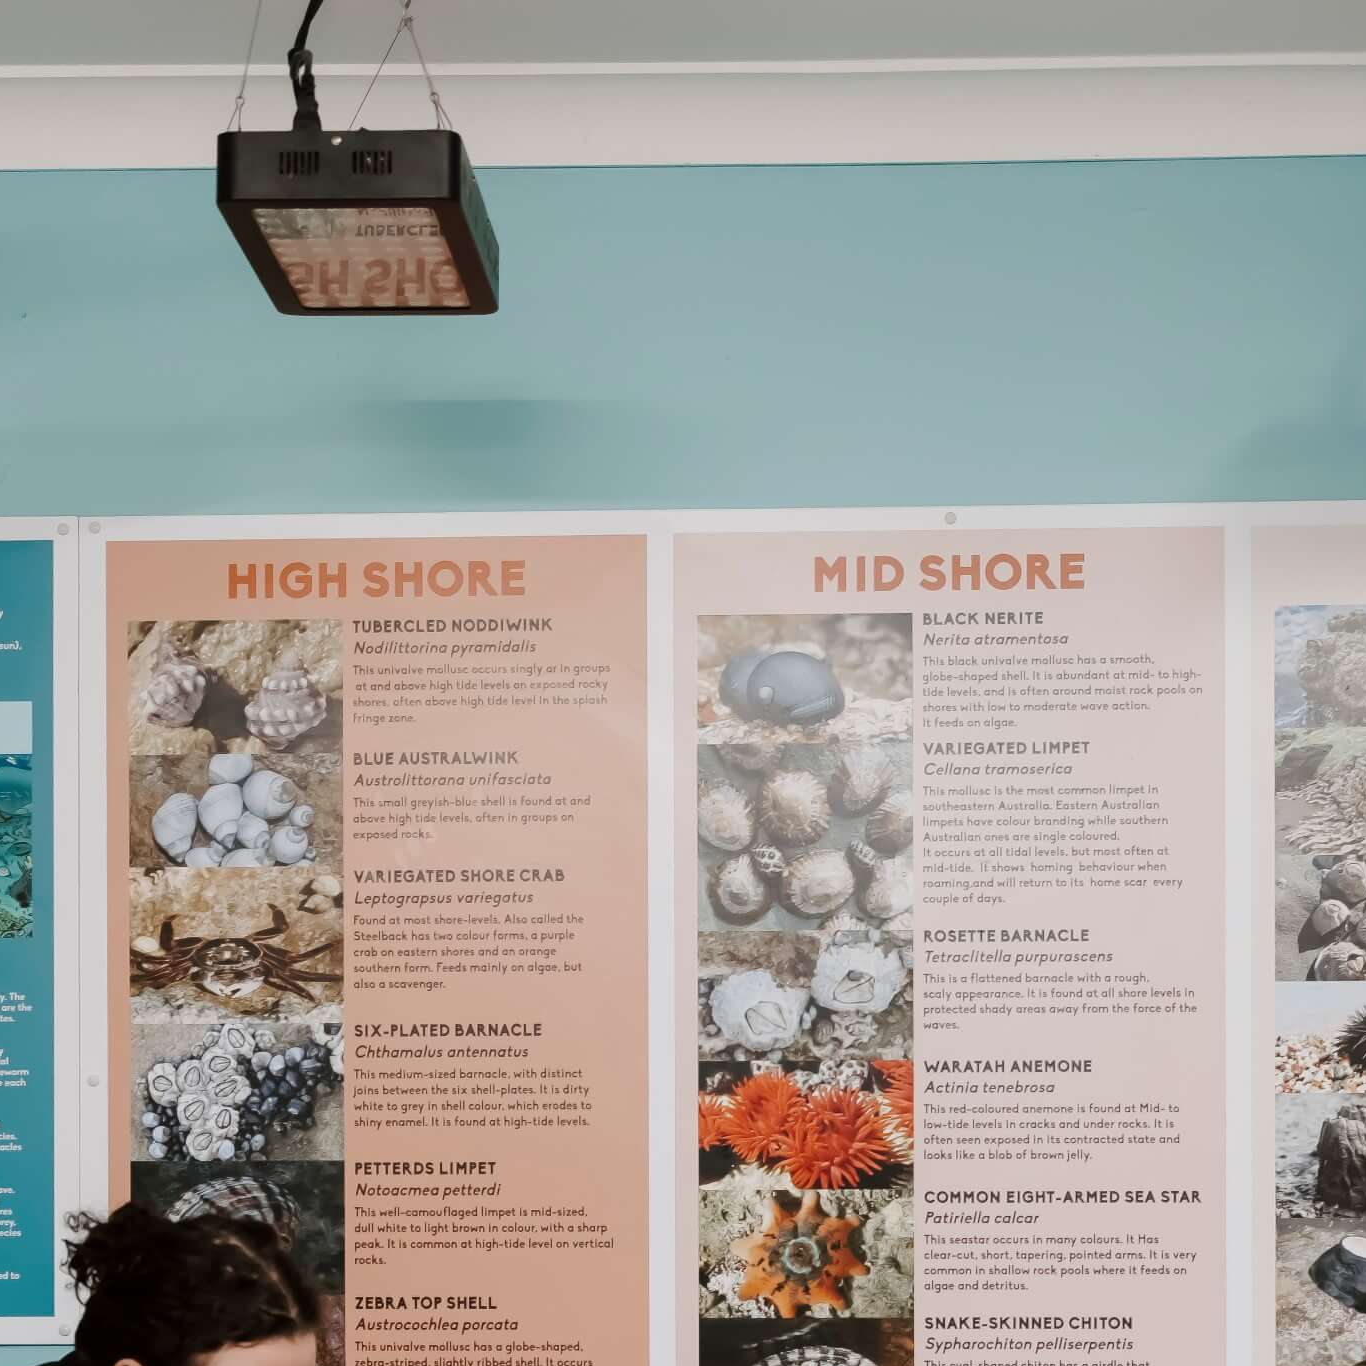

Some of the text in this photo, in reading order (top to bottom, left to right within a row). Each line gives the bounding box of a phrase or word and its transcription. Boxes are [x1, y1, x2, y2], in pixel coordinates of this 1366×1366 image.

[227, 559, 526, 600] HIGH SHORE
[814, 552, 1085, 593] MID SHORE
[351, 617, 553, 634] TUBERCLED NODDIWINK
[922, 611, 1044, 626] BLACK NERITE
[922, 741, 1091, 756] VARIEGATED LIMPET
[353, 751, 518, 766] BLUE AUSTRALWINK
[353, 868, 565, 884] VARIEGATED SHORE CRAB
[923, 928, 1090, 943] ROSETTE BARNACLE
[354, 1023, 542, 1038] SIX-PLATED BARNACLE
[923, 1059, 1092, 1073] WARATAH ANEMONE
[923, 1079, 1055, 1094] Actinia tenebrosa
[354, 1161, 497, 1176] PETTERDS LIMPET
[924, 1190, 1202, 1204] COMMON EIGHT-ARMED SEA STAR
[354, 1296, 498, 1310] ZEBRA TOP SHELL
[354, 1317, 519, 1336] Austrocochlea porcata
[924, 1316, 1133, 1330] SNAKE-SKINNED CHITON
